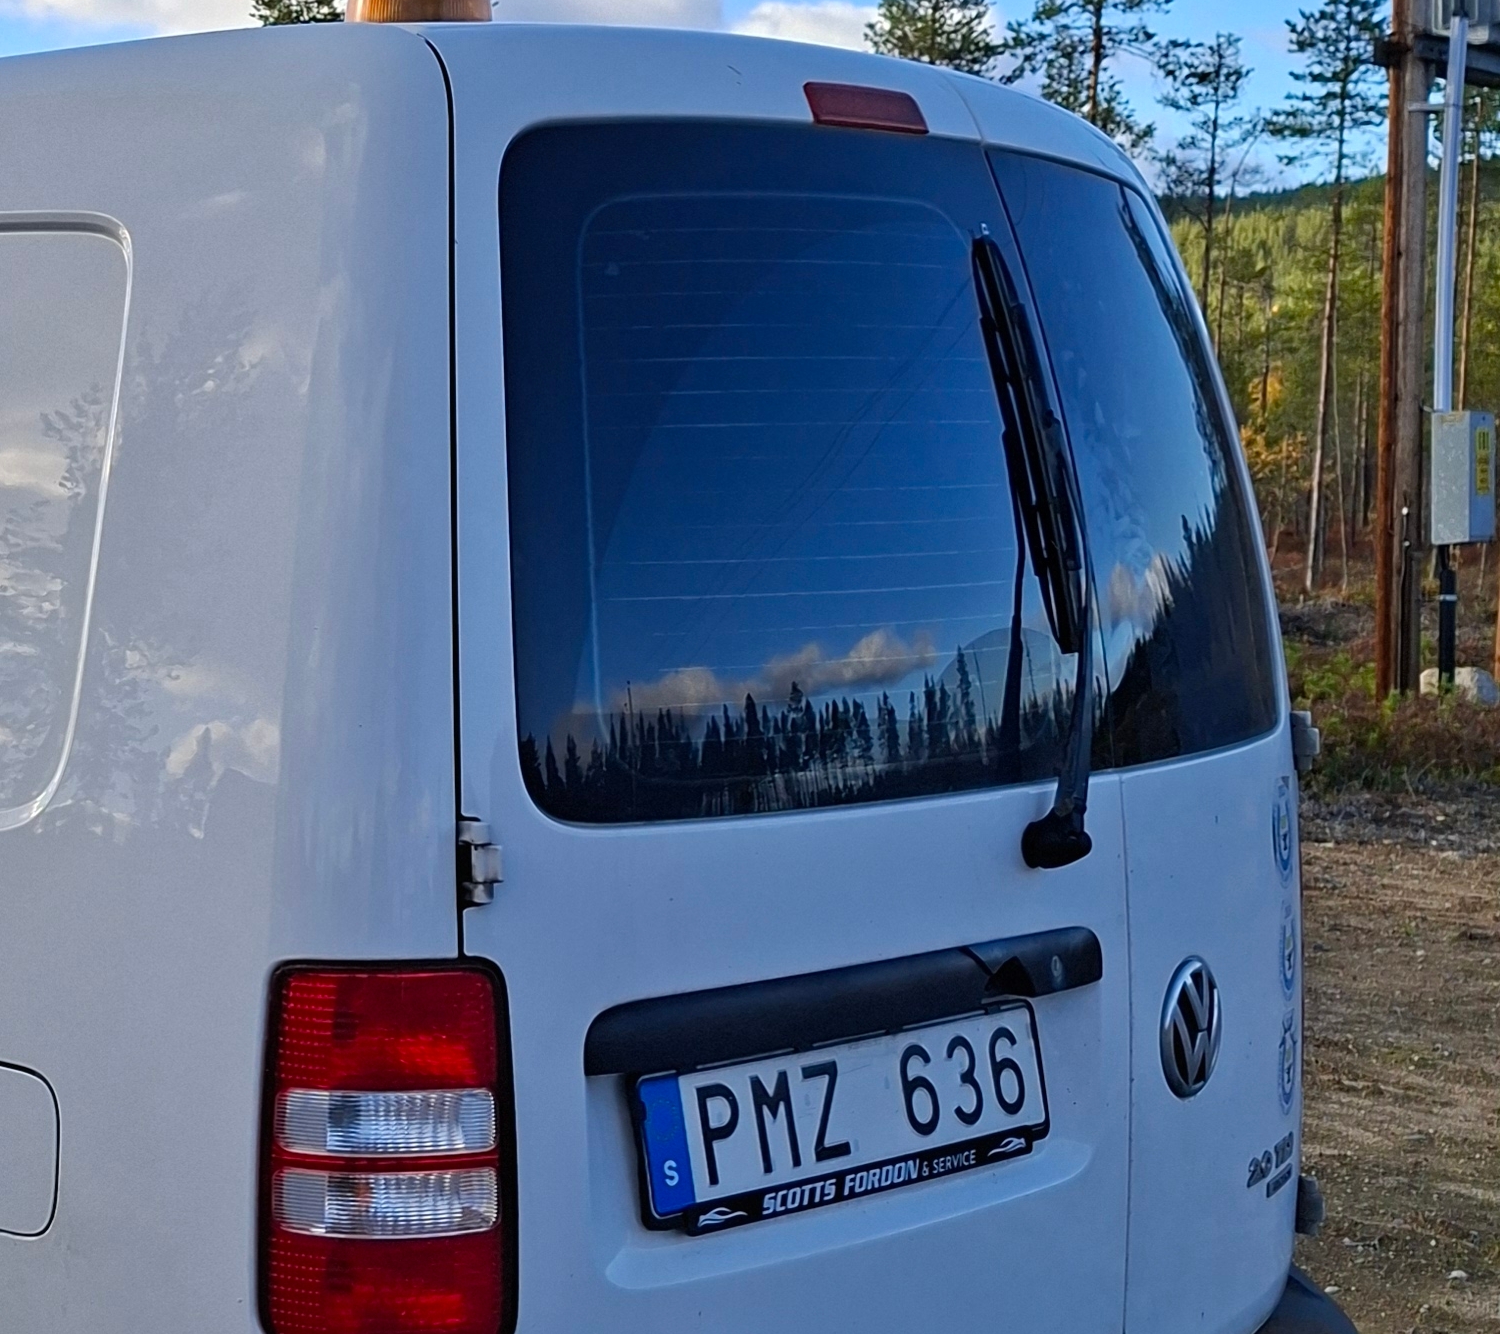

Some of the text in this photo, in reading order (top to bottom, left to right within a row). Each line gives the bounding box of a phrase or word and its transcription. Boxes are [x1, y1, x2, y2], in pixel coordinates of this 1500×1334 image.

[695, 1026, 1026, 1186] PMZ 636
[663, 1159, 680, 1186] S
[762, 1149, 977, 1216] SCOTTS FORDON & SERVICE
